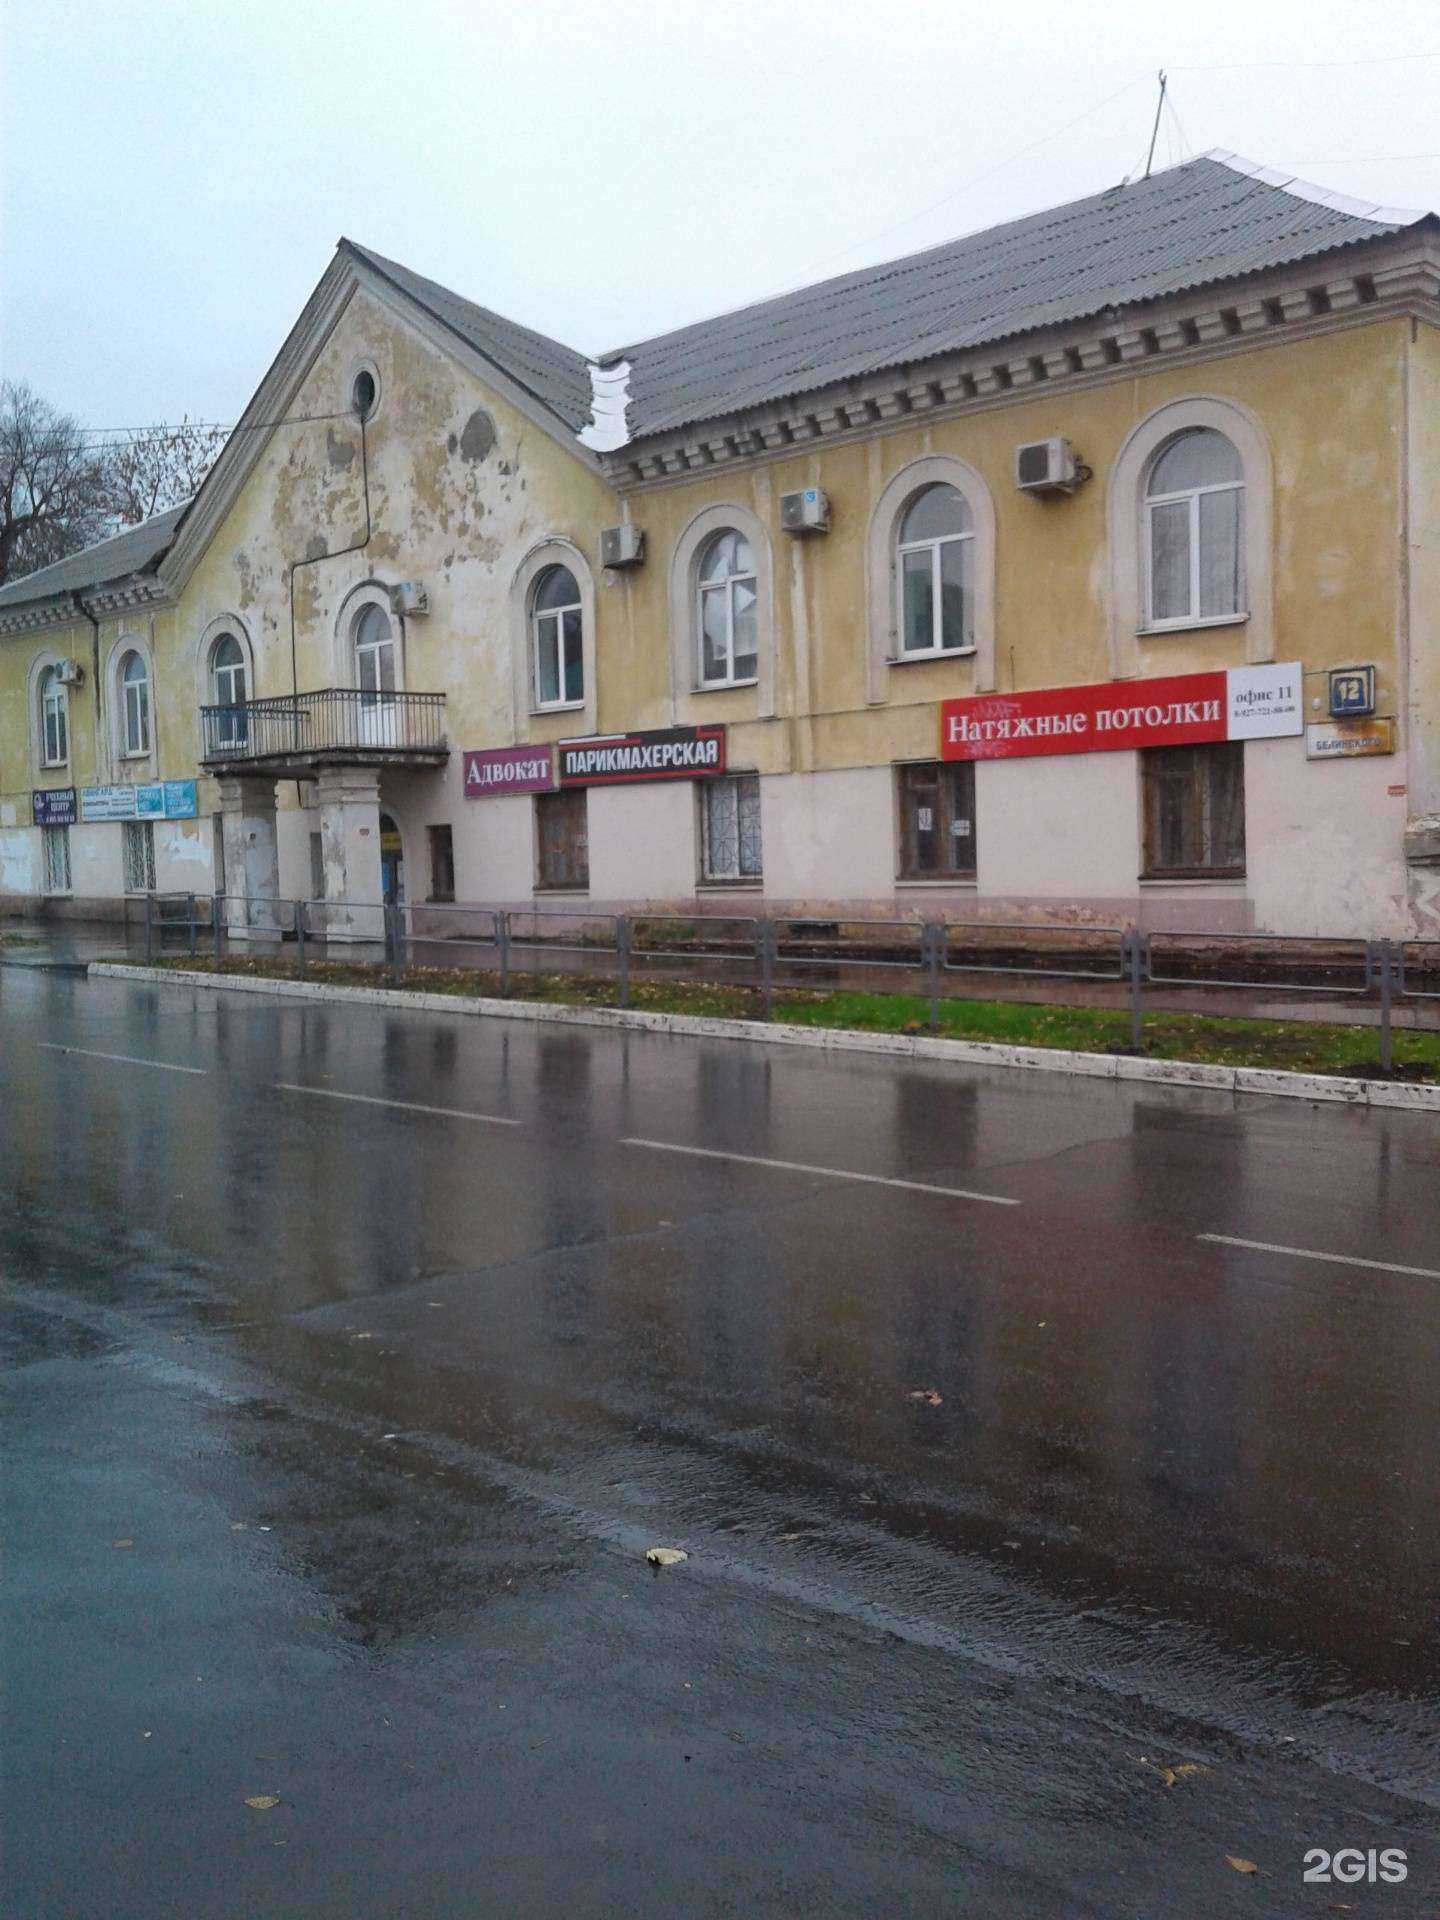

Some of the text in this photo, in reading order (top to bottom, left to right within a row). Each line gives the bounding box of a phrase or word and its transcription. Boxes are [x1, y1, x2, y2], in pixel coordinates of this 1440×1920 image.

[1236, 686, 1293, 706] офис 11
[1338, 679, 1360, 702] 12
[947, 700, 1221, 743] Натяжные потолки
[566, 739, 718, 774] ПАРИКМАХЕРСКАЯ
[466, 758, 549, 786] Адвокат
